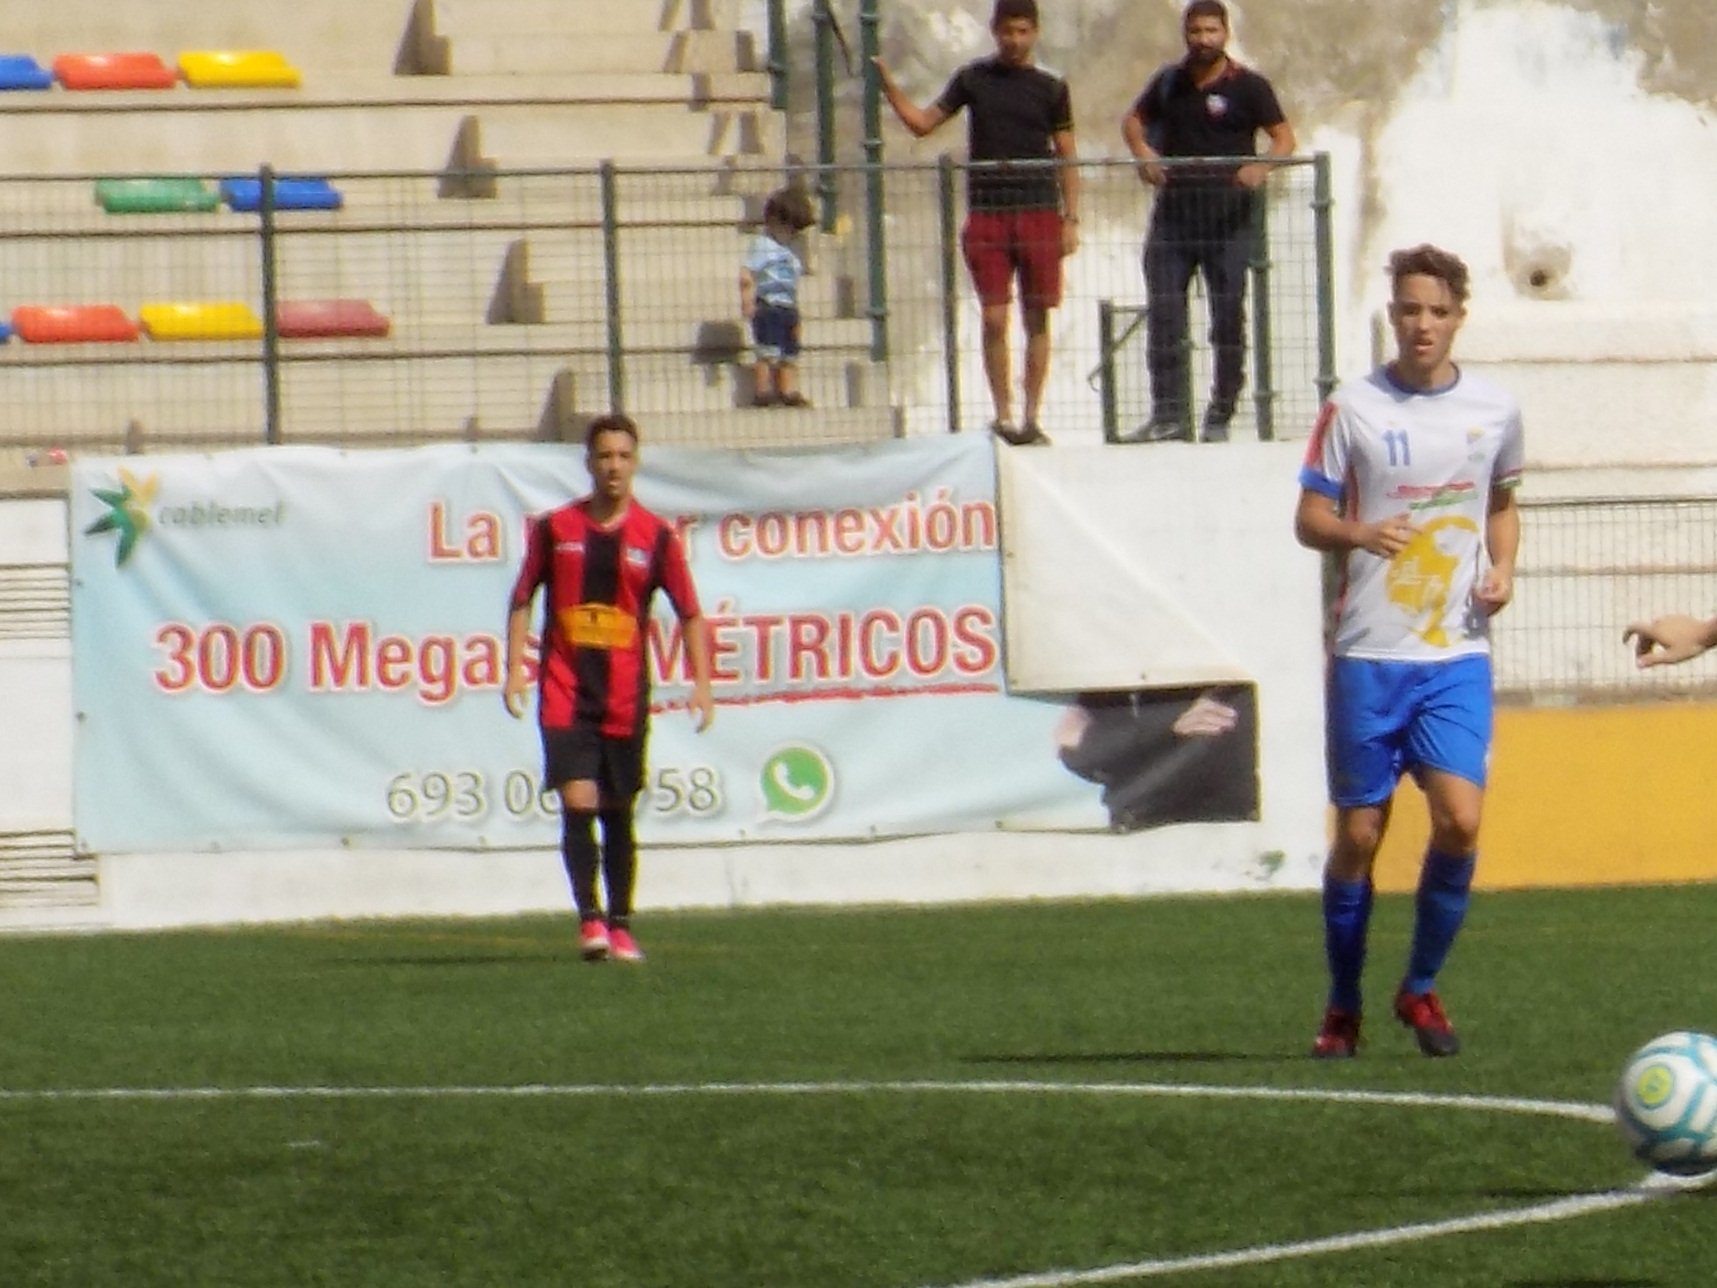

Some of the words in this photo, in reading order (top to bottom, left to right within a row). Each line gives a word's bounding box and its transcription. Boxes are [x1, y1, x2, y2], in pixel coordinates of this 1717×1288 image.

[1382, 428, 1412, 467] 11
[428, 500, 501, 560] La
[717, 488, 996, 560] conexión
[154, 622, 287, 691] 300
[647, 599, 998, 686] MÉTRICOS
[387, 770, 486, 816] 693
[650, 767, 720, 813] 58
